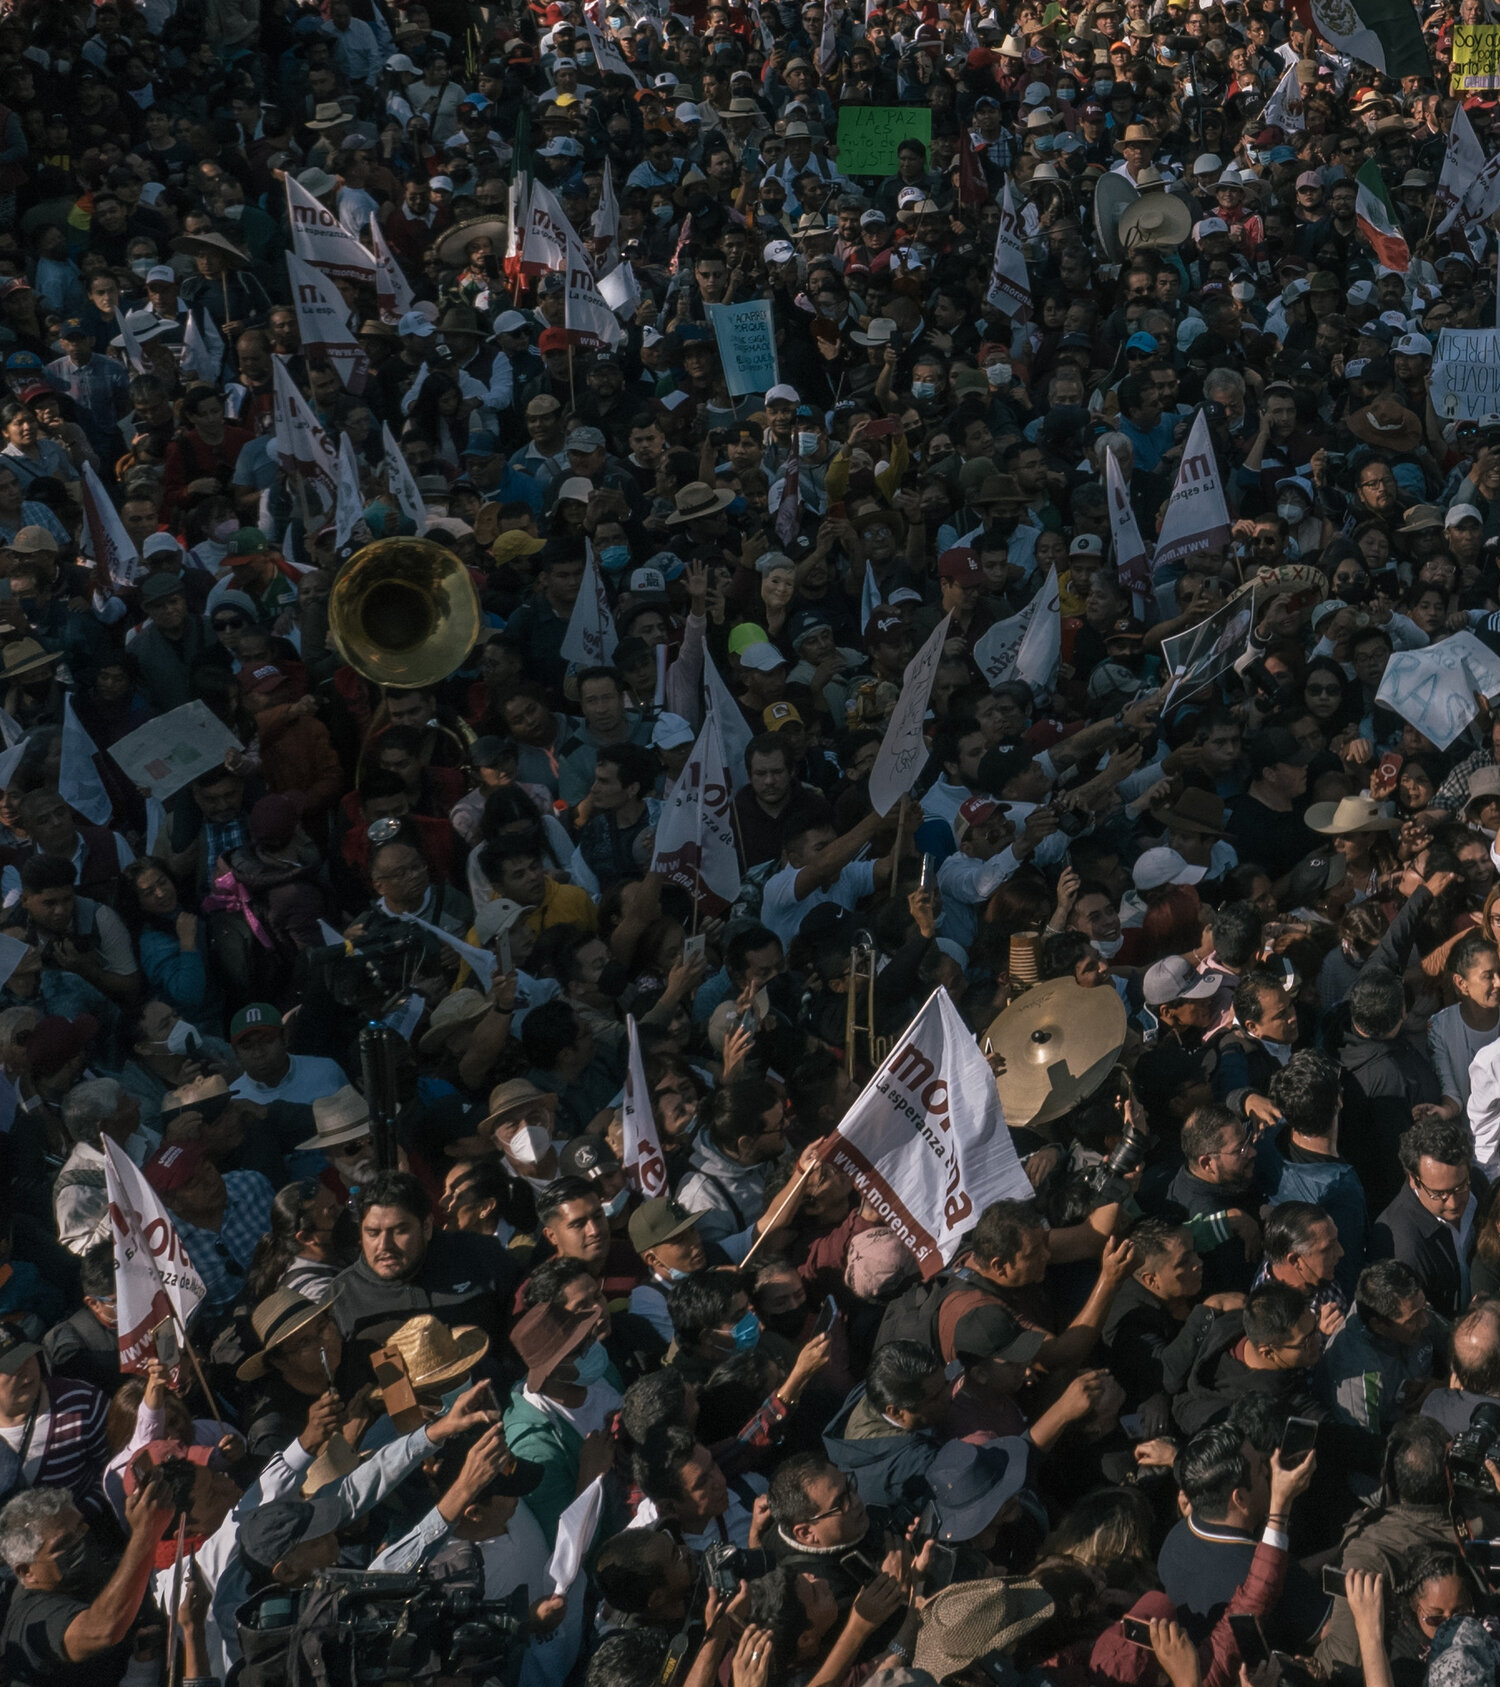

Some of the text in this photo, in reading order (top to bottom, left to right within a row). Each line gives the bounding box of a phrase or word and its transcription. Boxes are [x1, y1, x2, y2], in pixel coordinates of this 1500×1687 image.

[1455, 26, 1482, 54] Soy
[1455, 60, 1480, 75] arta
[1483, 61, 1497, 73] de
[856, 108, 917, 127] LA PAZ
[874, 124, 894, 134] ES
[843, 148, 897, 168] JUSTI
[292, 205, 342, 229] mo
[572, 269, 594, 292] m
[317, 307, 336, 317] esp
[1466, 395, 1488, 418] LA
[876, 1075, 948, 1159] La esperanza
[833, 1155, 934, 1265] www.morena.si
[153, 1269, 179, 1288] nza
